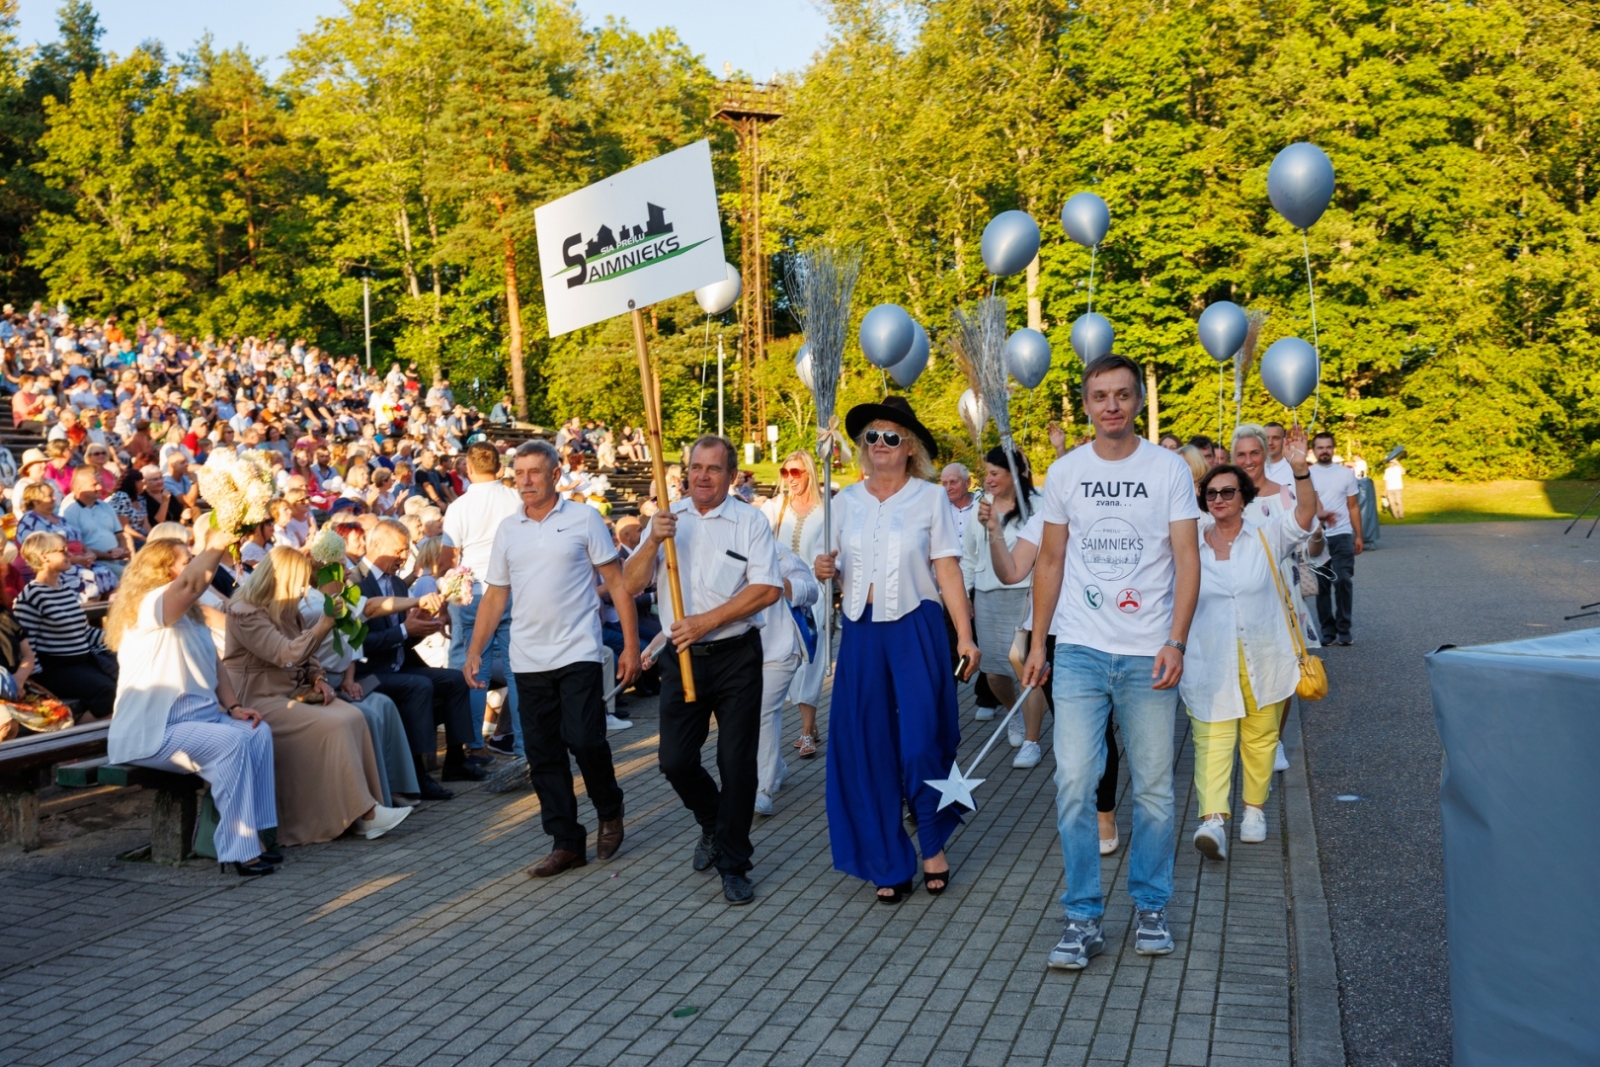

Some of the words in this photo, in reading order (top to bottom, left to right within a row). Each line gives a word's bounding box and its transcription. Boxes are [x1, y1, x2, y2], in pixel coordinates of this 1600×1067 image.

[600, 244, 615, 255] SIA
[562, 232, 680, 289] SAIMNIEKS
[1080, 481, 1149, 498] TAUTA
[1080, 538, 1144, 551] SAIMNIEKS
